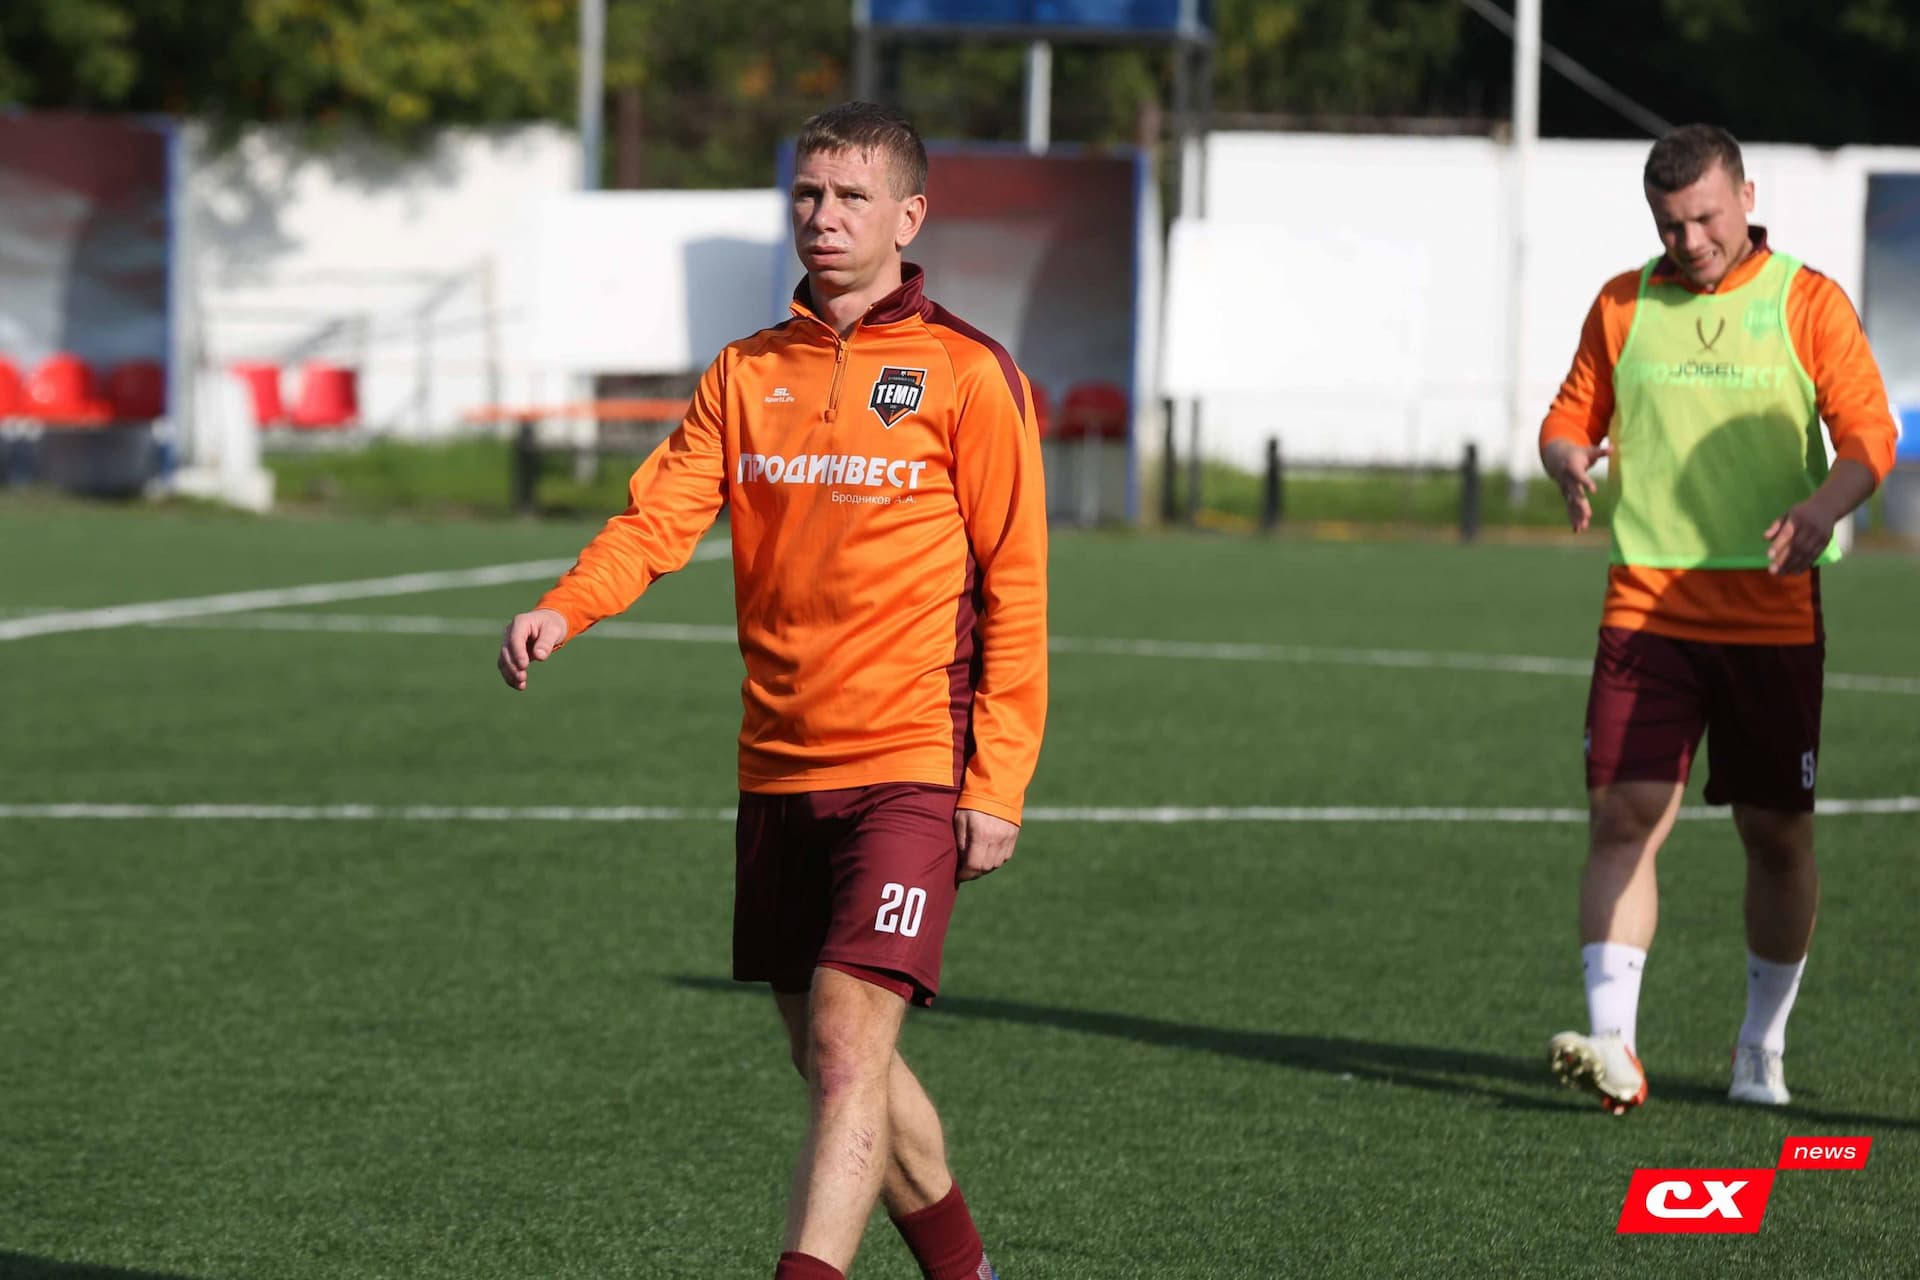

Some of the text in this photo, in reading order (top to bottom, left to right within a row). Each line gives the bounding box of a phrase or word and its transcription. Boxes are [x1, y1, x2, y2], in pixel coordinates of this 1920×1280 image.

[1670, 359, 1743, 377] JÖGEL
[876, 384, 920, 408] ТЕМП
[737, 453, 926, 490] ПРОДИНВЕСТ
[831, 491, 891, 505] Бродников
[874, 883, 927, 937] 20
